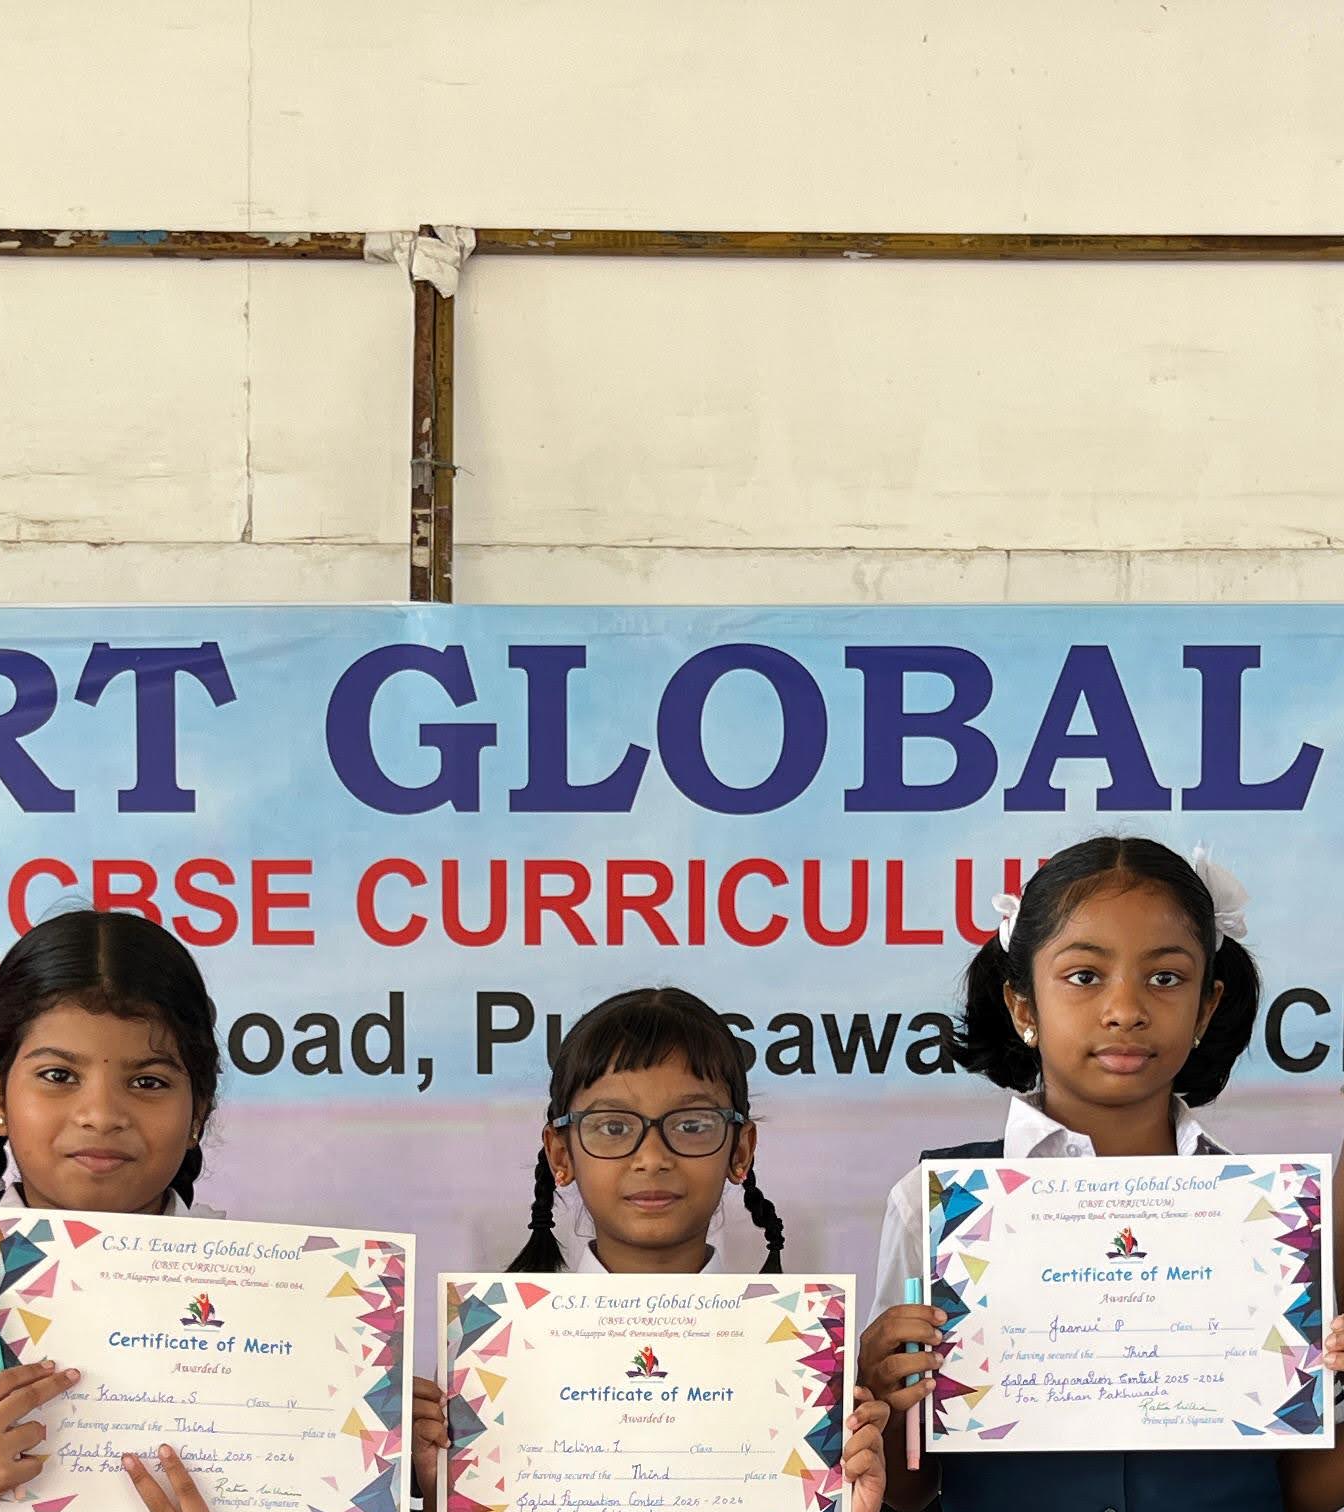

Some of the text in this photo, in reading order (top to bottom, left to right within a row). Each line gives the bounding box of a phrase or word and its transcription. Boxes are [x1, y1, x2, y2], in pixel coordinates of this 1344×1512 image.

[325, 642, 1324, 814] GLOBAL
[356, 857, 1052, 947] CURRICULU
[217, 991, 433, 1093] oad,
[1074, 1178, 1120, 1193] Ewart
[1124, 1176, 1170, 1196] Global
[1172, 1175, 1221, 1191] School
[1078, 1198, 1175, 1209] (CBSE CURRICULUM)
[148, 1238, 197, 1254] Ewart
[203, 1240, 252, 1260] Global
[254, 1244, 305, 1261] School
[152, 1260, 256, 1275] (CBSE CURRICULUM)
[1041, 1266, 1213, 1283] Certificate of Merit
[275, 1281, 289, 1289] 600
[594, 1295, 641, 1309] Ewart
[646, 1294, 692, 1313] Global
[694, 1293, 743, 1309] School
[1099, 1292, 1156, 1304] Awarded to
[598, 1316, 697, 1326] (CBSE CURRICULUM)
[1001, 1325, 1027, 1334] Name
[1170, 1322, 1193, 1333] Class
[716, 1330, 729, 1338] 600
[108, 1332, 293, 1355] Certificate of Merit
[999, 1350, 1094, 1363] for having secured the
[1123, 1344, 1160, 1359] Third
[1224, 1348, 1258, 1359] place in
[172, 1363, 232, 1375] Awarded to
[1164, 1374, 1190, 1384] 2025
[62, 1391, 90, 1400] Name
[560, 1386, 734, 1401] Certificate of Merit
[246, 1398, 271, 1409] Class
[619, 1412, 675, 1424] Awarded to
[1187, 1416, 1224, 1427] Signature
[57, 1417, 163, 1432] for having secured the
[174, 1417, 217, 1434] Third
[301, 1428, 336, 1440] place in
[518, 1444, 543, 1453] Name
[689, 1443, 712, 1454] Class
[224, 1450, 252, 1462] 2025
[265, 1452, 295, 1462] 2026
[516, 1470, 612, 1482] for having secured the
[631, 1464, 670, 1480] Third
[744, 1472, 778, 1483] place in
[260, 1497, 299, 1509] Signature
[561, 1490, 622, 1511] Preparation
[629, 1491, 665, 1506] Contest
[672, 1496, 700, 1507] 2025
[712, 1495, 744, 1505] 2026
